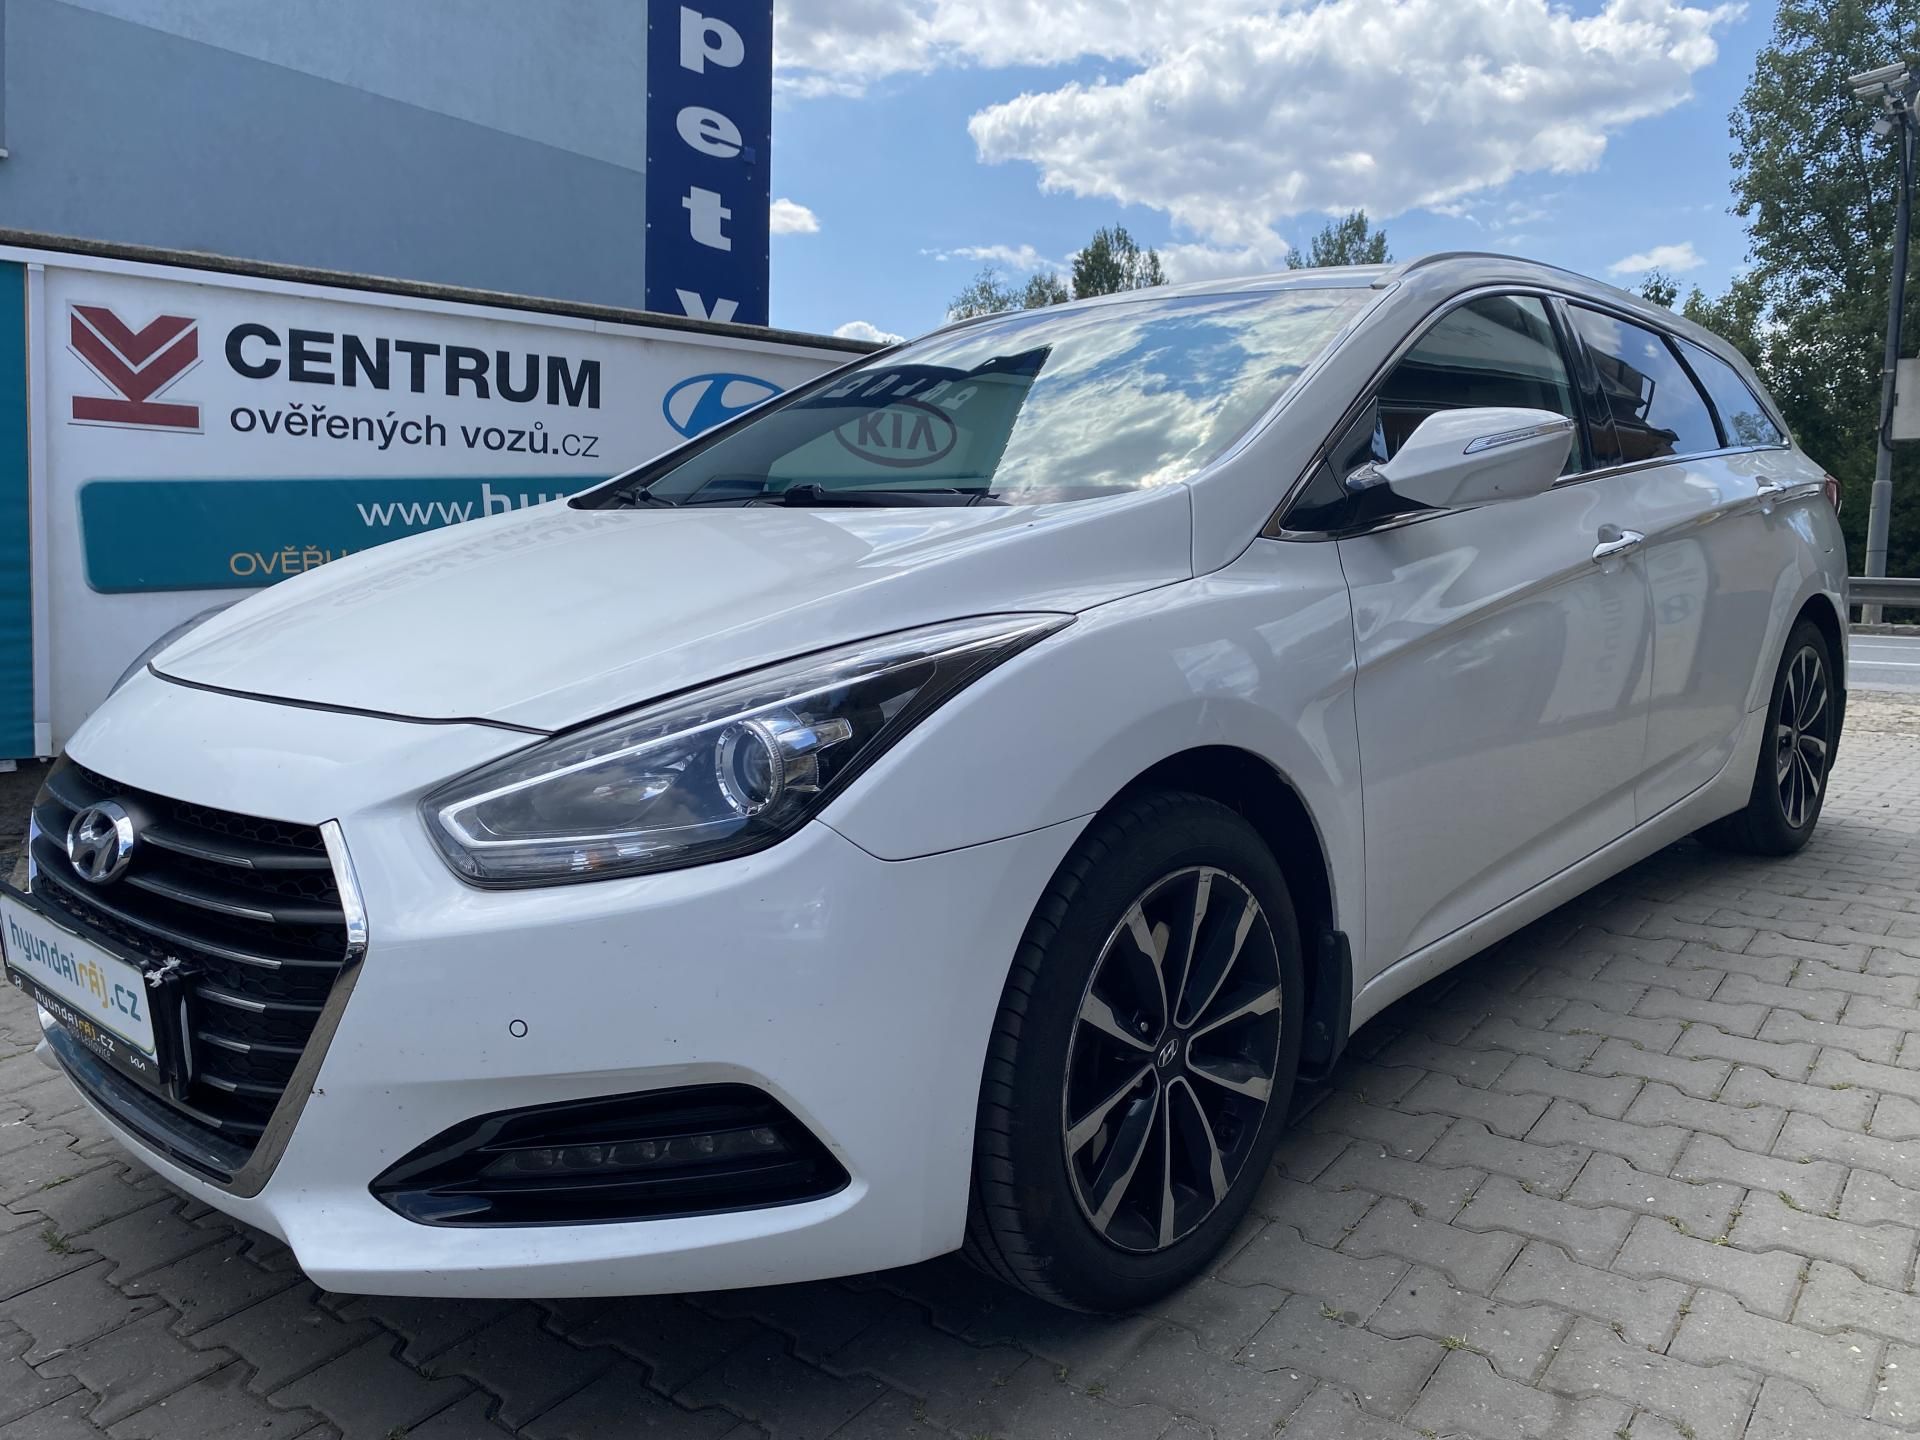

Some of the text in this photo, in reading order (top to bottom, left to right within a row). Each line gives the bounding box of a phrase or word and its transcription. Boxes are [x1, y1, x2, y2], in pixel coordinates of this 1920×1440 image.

[225, 323, 601, 409] CENTRUM
[230, 402, 599, 457] ověřených vozů.cz
[857, 411, 937, 452] KIA
